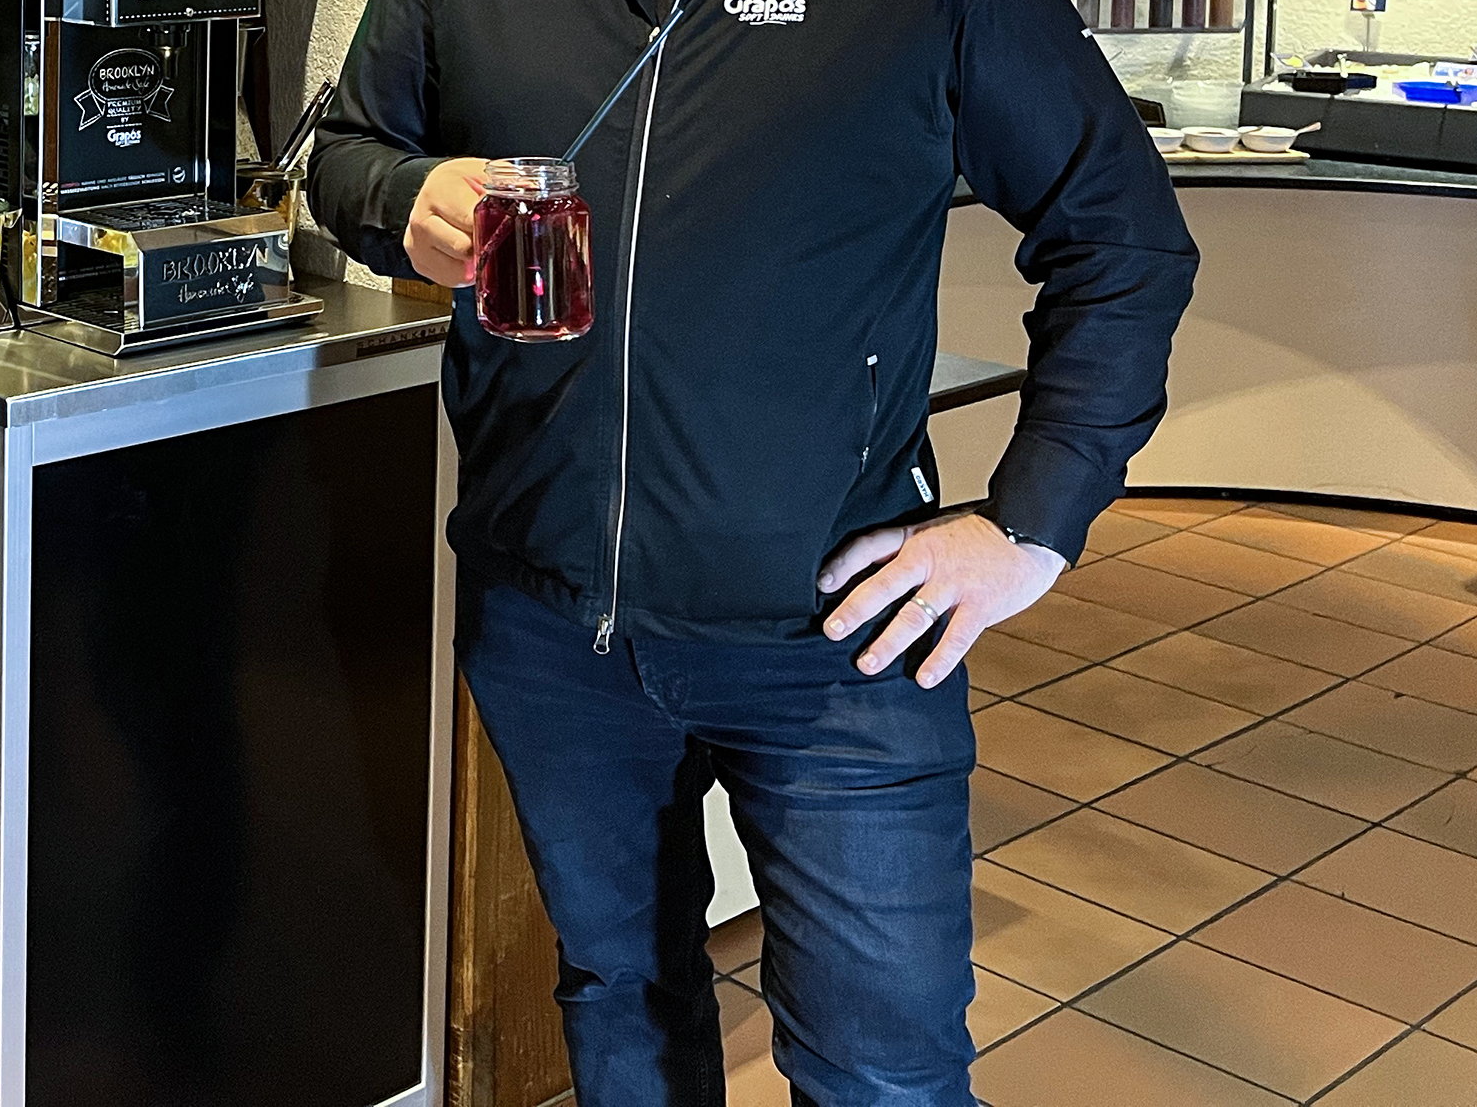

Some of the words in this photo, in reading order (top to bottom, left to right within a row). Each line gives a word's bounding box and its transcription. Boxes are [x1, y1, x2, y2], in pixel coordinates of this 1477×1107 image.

[738, 13, 764, 22] SOFT
[99, 64, 155, 81] BROOKLYN
[107, 99, 142, 108] PREMIUM
[107, 105, 142, 115] QUALITY
[163, 244, 269, 282] BROOKLYN
[357, 326, 447, 348] SCHANKOMA
